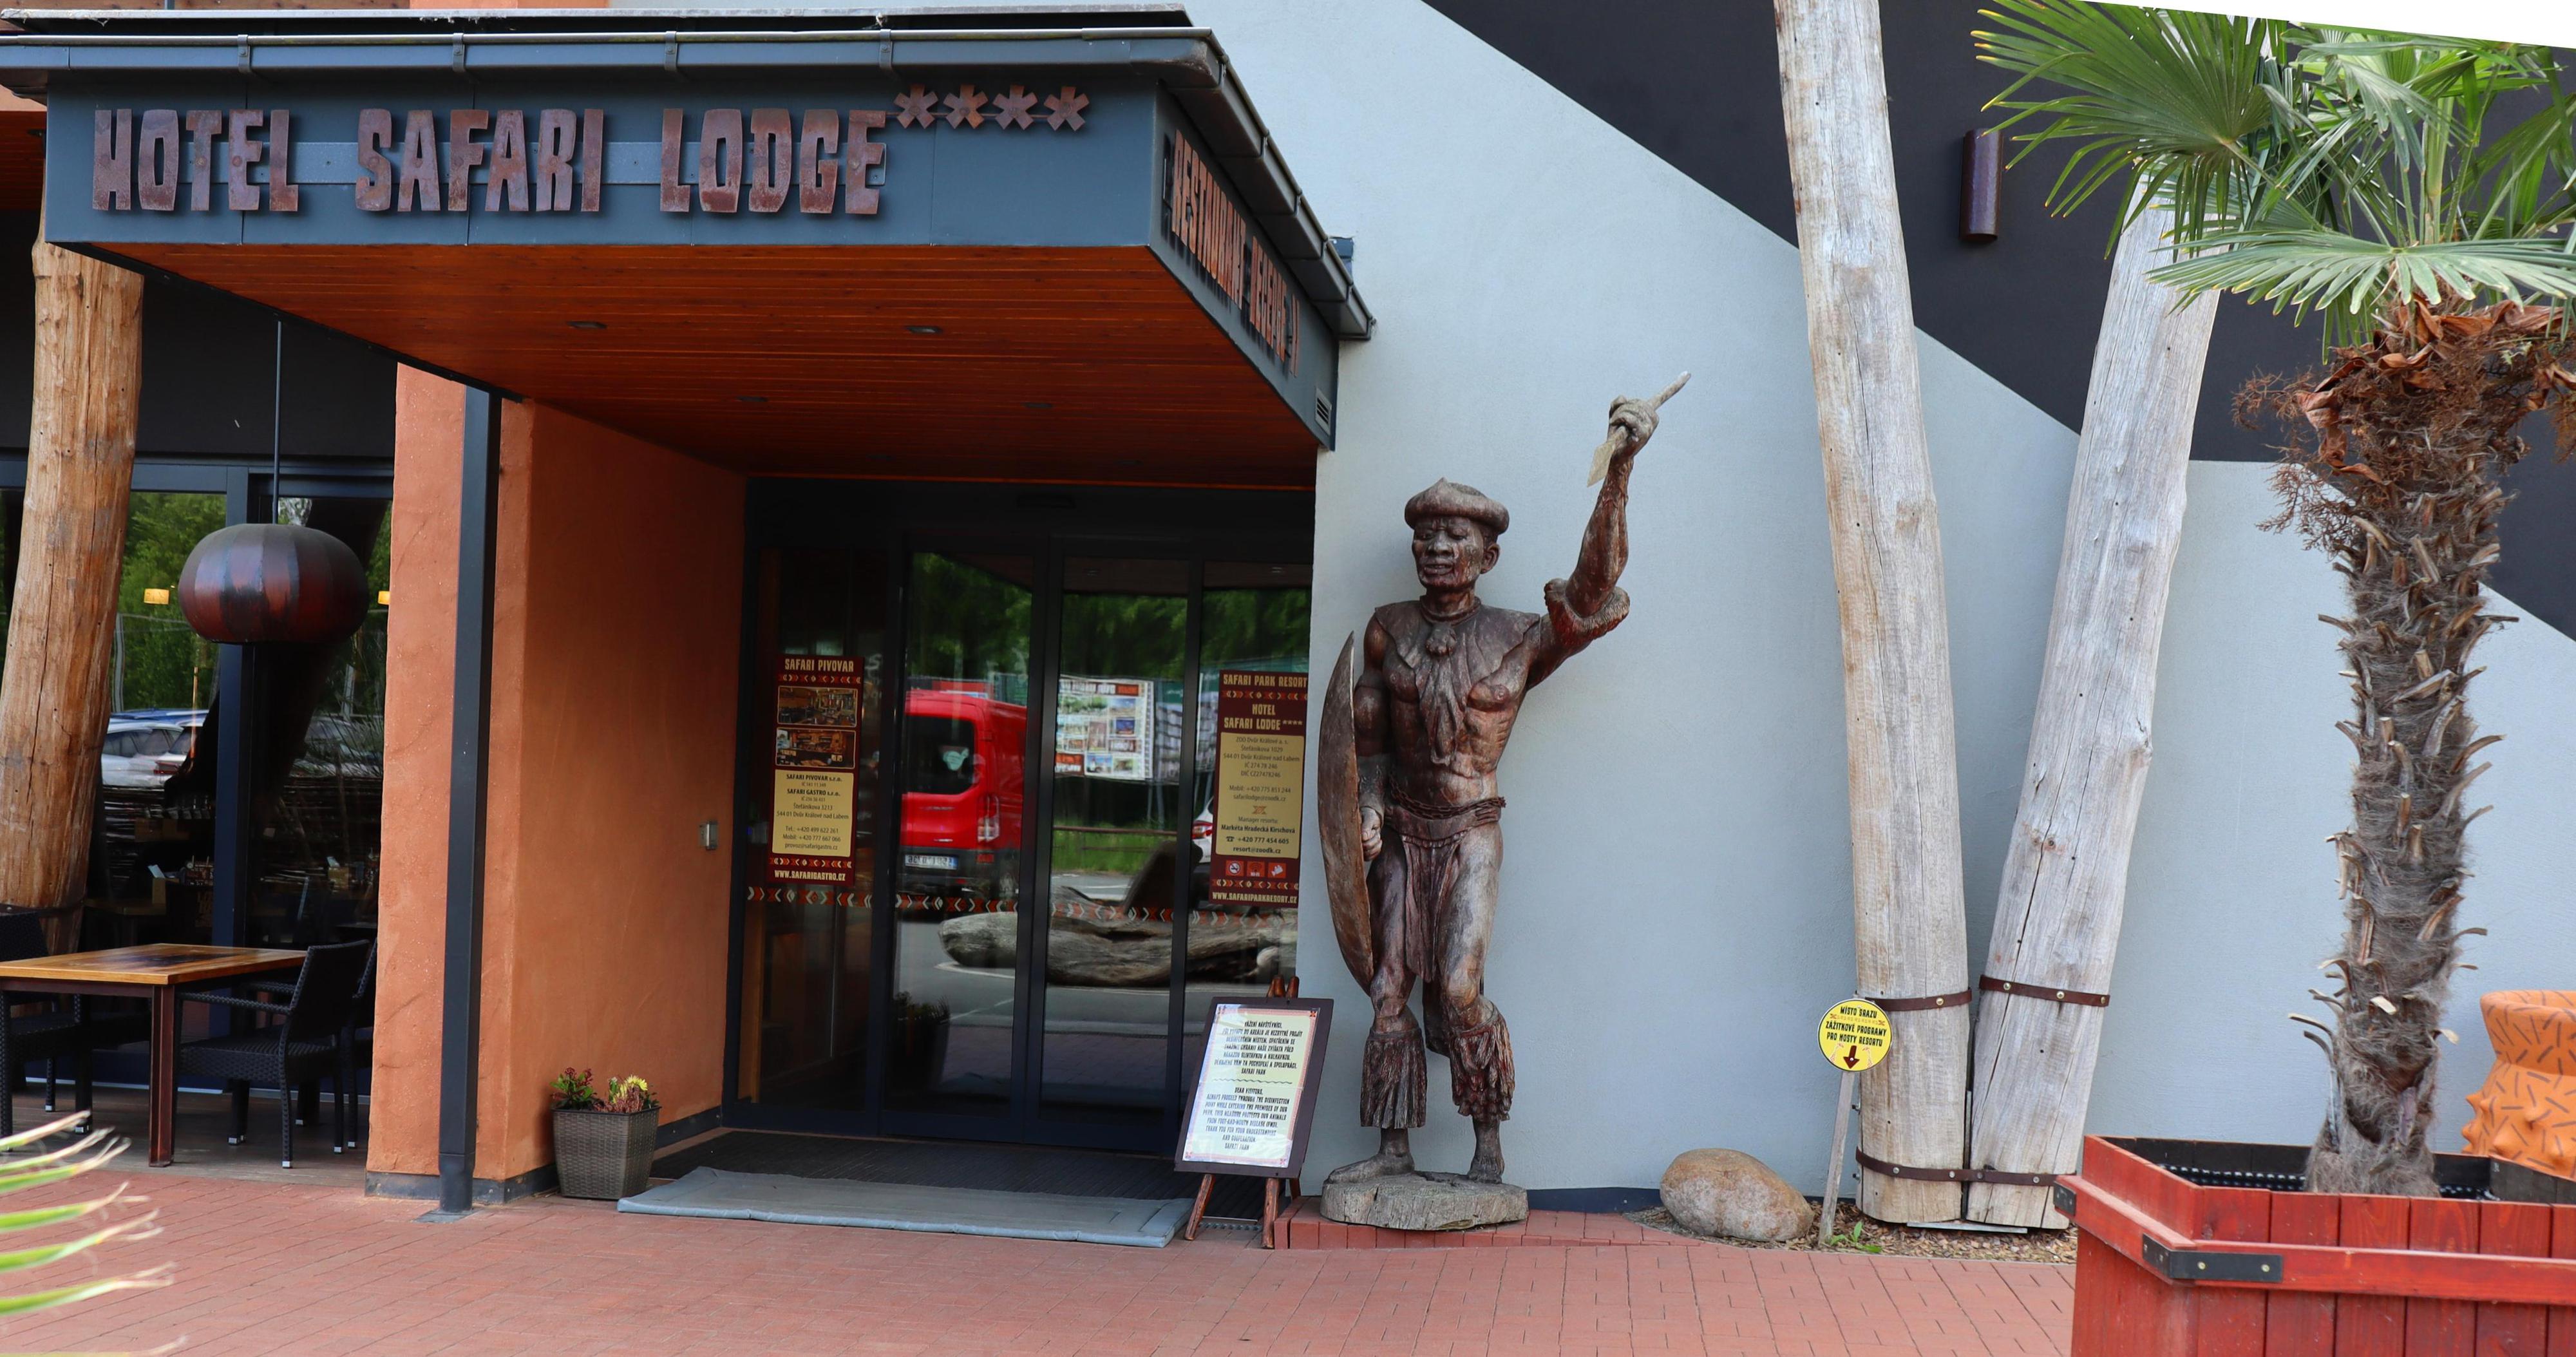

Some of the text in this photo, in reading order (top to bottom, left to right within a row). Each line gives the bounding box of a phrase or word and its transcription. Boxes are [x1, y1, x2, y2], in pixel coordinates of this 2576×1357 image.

[93, 109, 299, 212] HOTEL
[355, 108, 604, 212] SAFARI
[660, 108, 886, 214] LODGE
[1171, 129, 1246, 310] RESTAURANT
[785, 659, 854, 672] SAFARI PIVOVAR
[1224, 674, 1307, 687] SAFARI PARK RESORT
[1252, 704, 1275, 716] HOTEL
[1224, 717, 1253, 729] SAFARI
[1256, 719, 1280, 730] LODGE
[775, 870, 845, 881] WWW.SAFARIGASTRO.CZ
[1212, 892, 1297, 904] WWW.SAFARIPARKRESORT.CZ
[1840, 1006, 1877, 1018] MÍSTO SRAZU
[1826, 1020, 1887, 1036] ZÁŽITKOVÉ PROGRAMY
[1827, 1032, 1882, 1047] PRO HOSTY RESORTU
